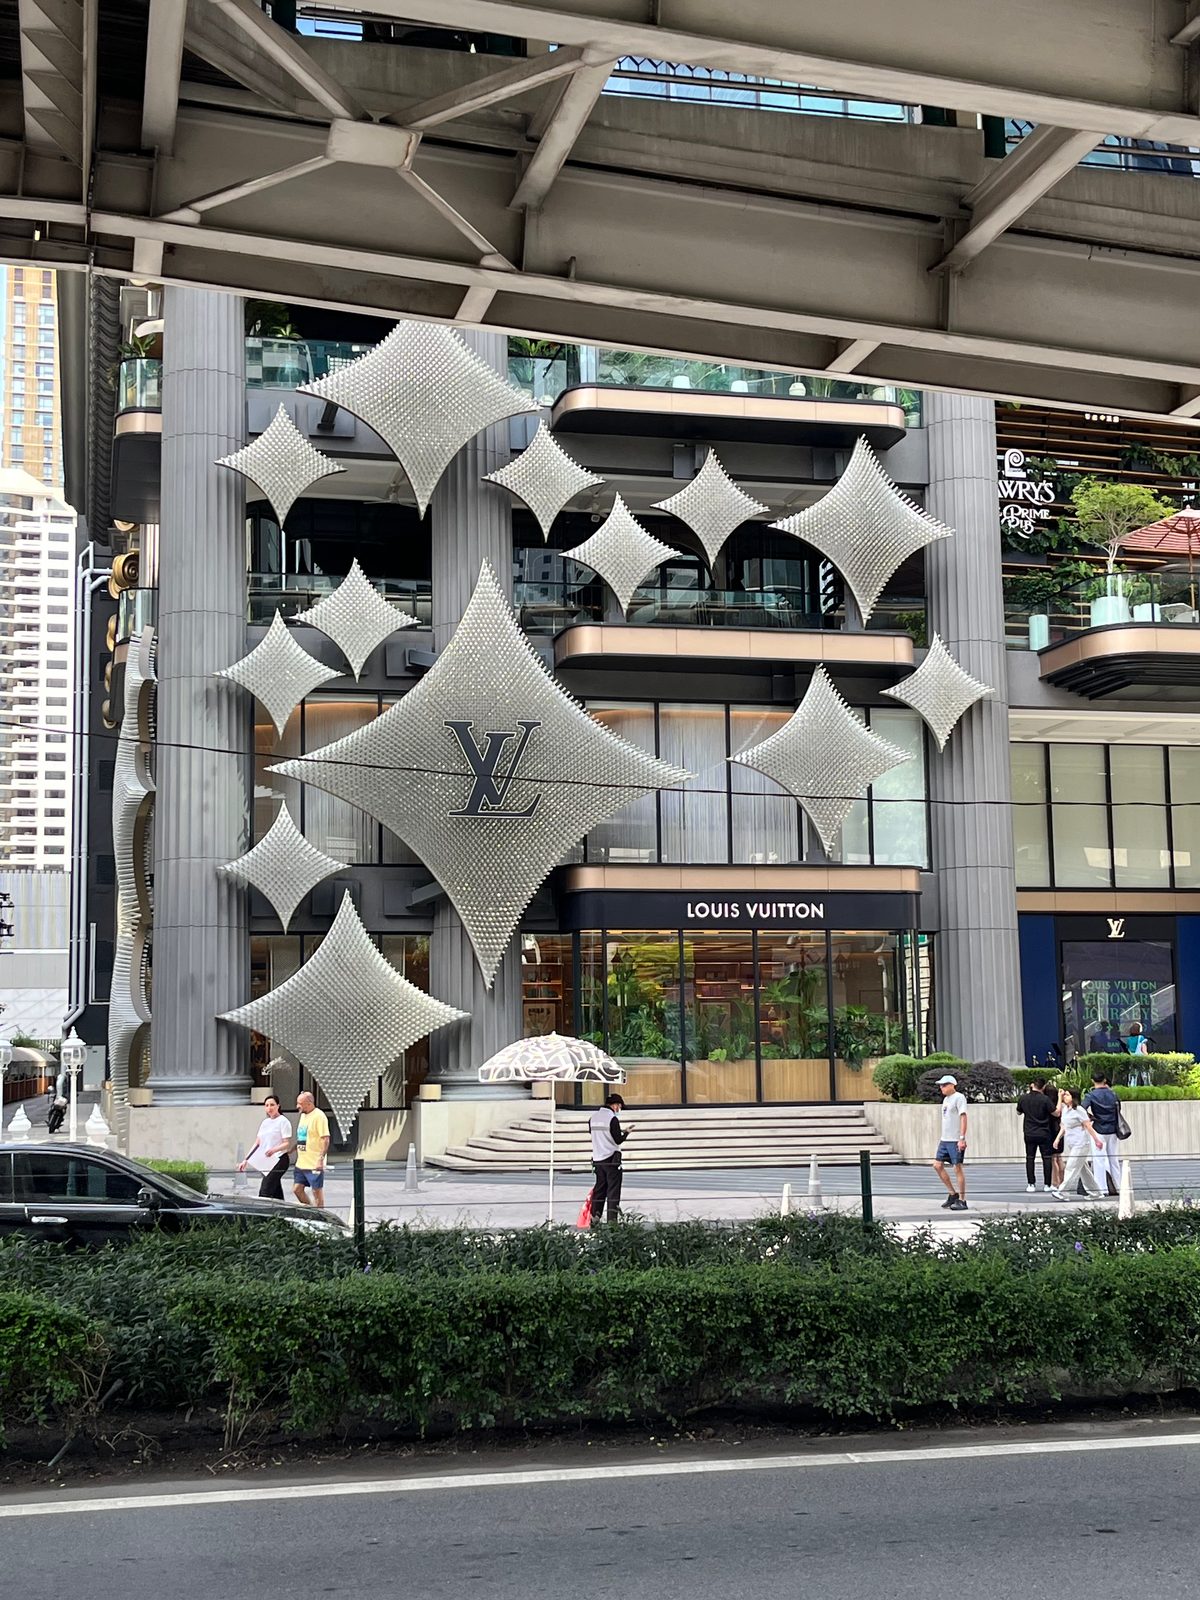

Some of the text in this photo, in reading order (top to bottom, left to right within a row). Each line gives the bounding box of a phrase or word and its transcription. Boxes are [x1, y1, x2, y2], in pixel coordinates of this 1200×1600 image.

[998, 480, 1055, 505] AWRY'S
[1002, 505, 1051, 523] PRIME
[687, 903, 824, 918] LOUIS VUITTON
